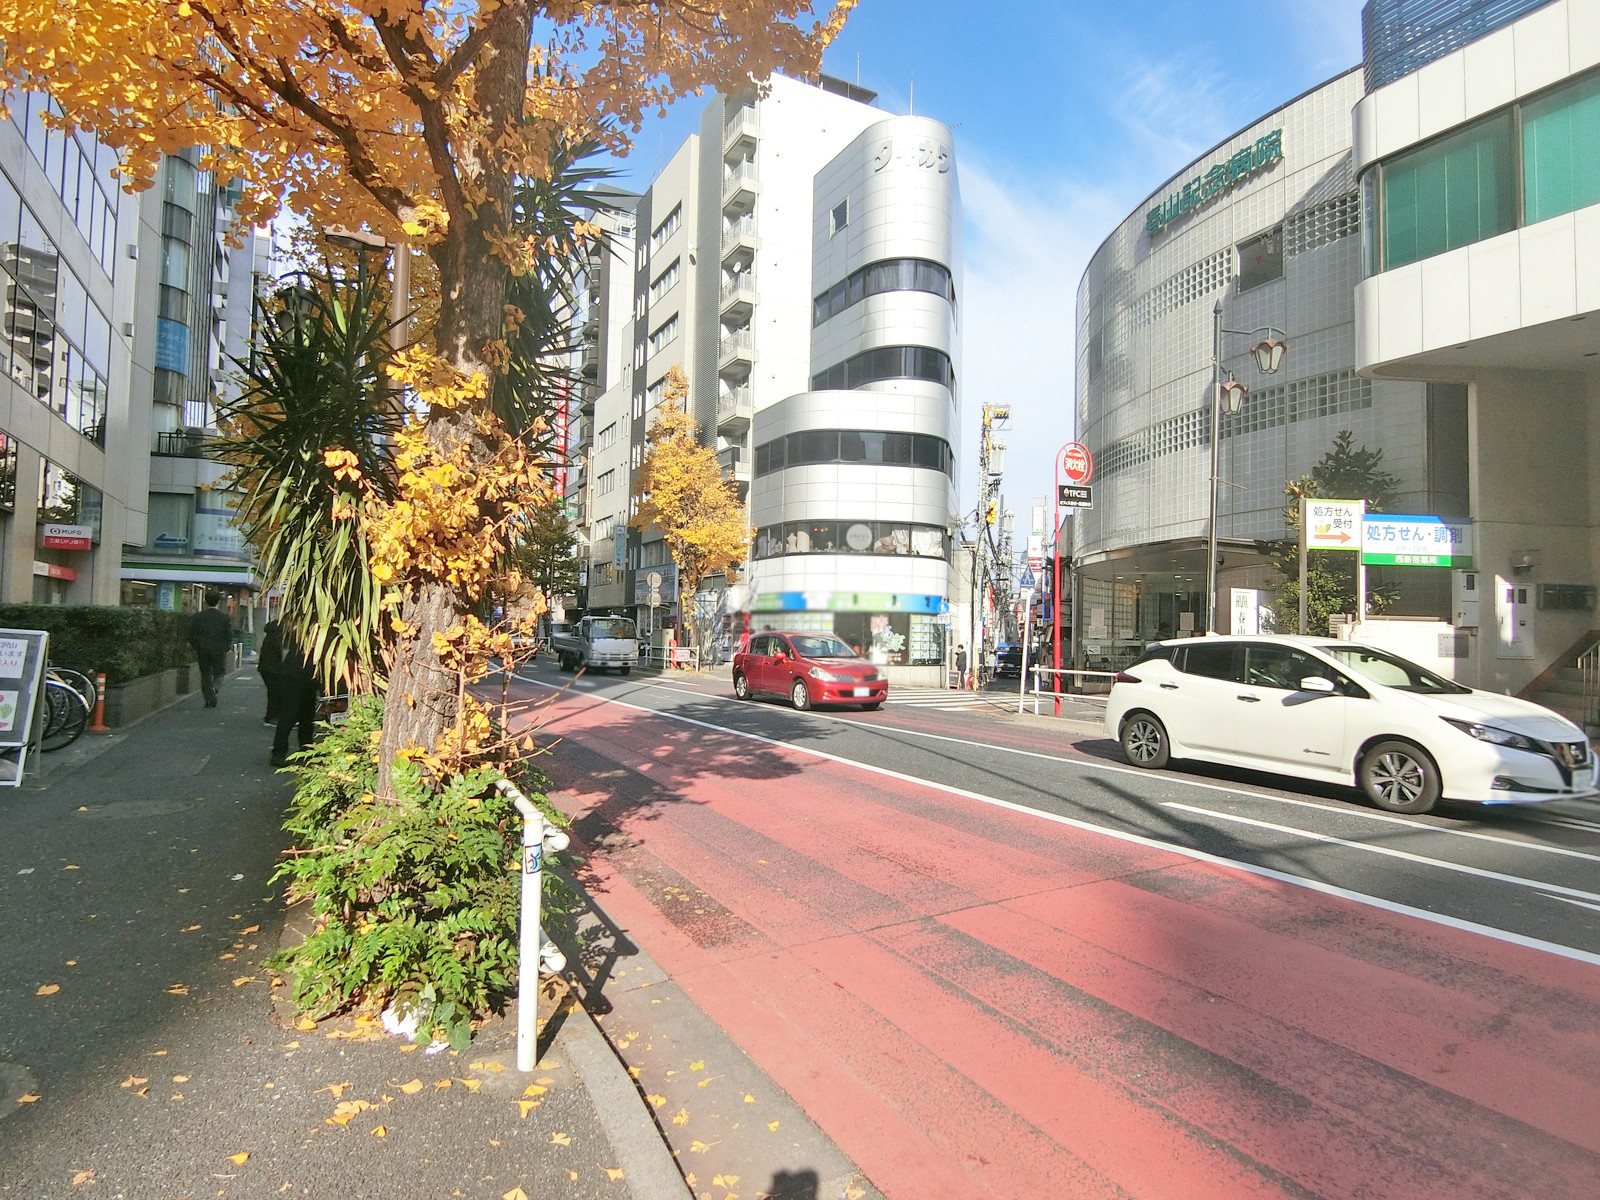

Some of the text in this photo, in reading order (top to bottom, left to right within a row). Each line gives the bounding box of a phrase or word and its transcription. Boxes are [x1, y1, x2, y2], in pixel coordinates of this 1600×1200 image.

[1146, 127, 1285, 237] 春山記念病院
[1065, 457, 1085, 472] 消火栓
[1313, 506, 1353, 517] 処方せん
[1333, 518, 1353, 529] 受付
[1366, 524, 1464, 544] 処方せん・調剤
[1395, 554, 1438, 565] 西新宿薬局
